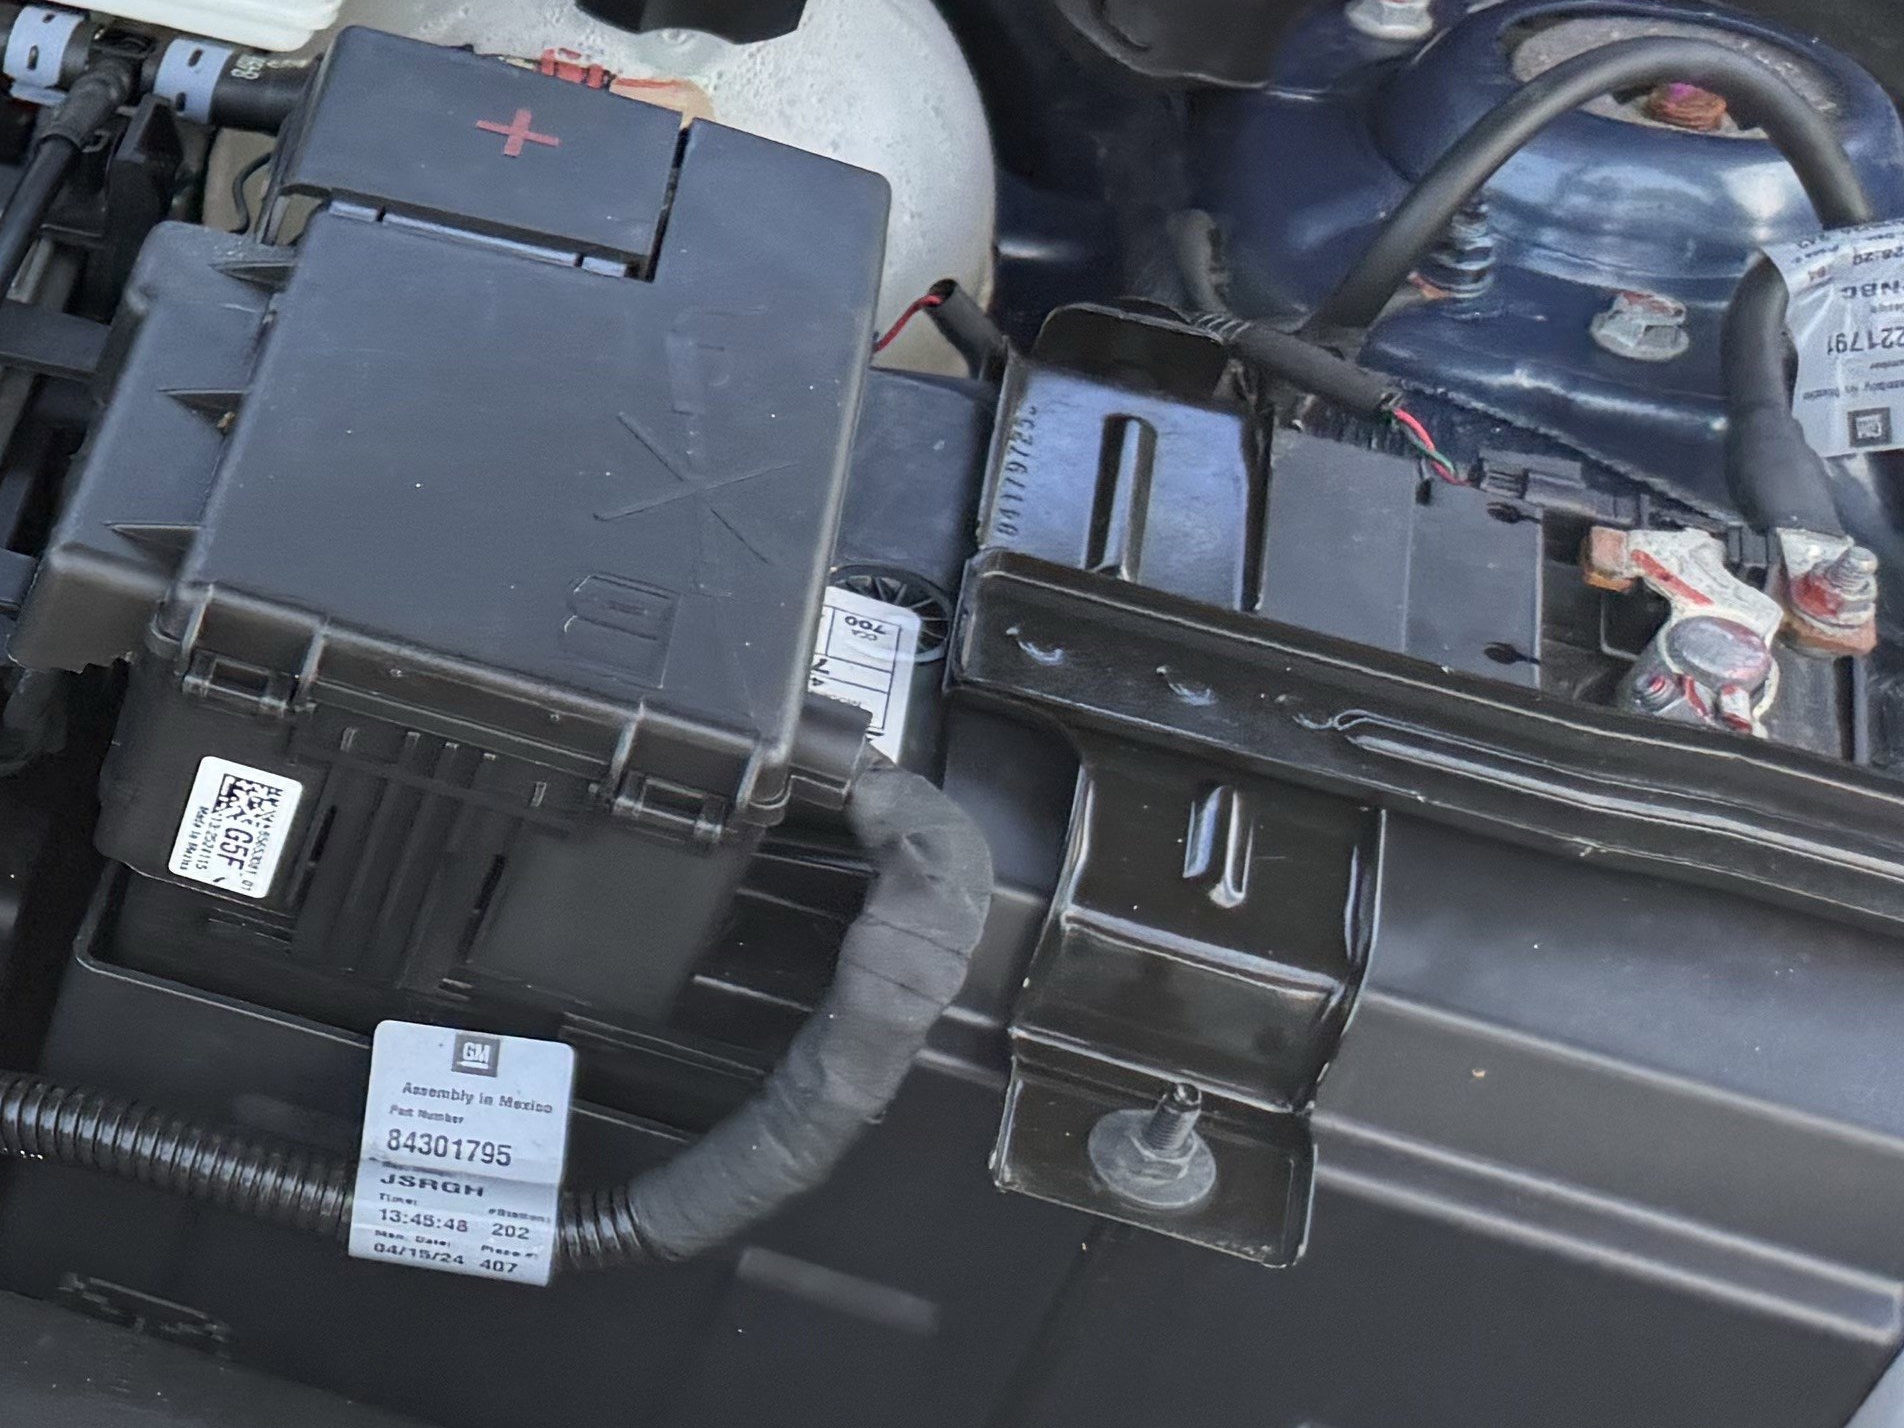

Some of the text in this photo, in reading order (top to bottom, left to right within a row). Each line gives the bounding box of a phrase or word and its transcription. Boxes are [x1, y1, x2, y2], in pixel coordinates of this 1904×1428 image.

[844, 615, 887, 635] 700
[217, 827, 254, 871] G5F
[462, 1041, 490, 1063] GM
[402, 1081, 554, 1115] Assembly in Mexico
[389, 1104, 465, 1125] Part Number
[386, 1127, 513, 1168] 84301795
[491, 1223, 531, 1241] 202
